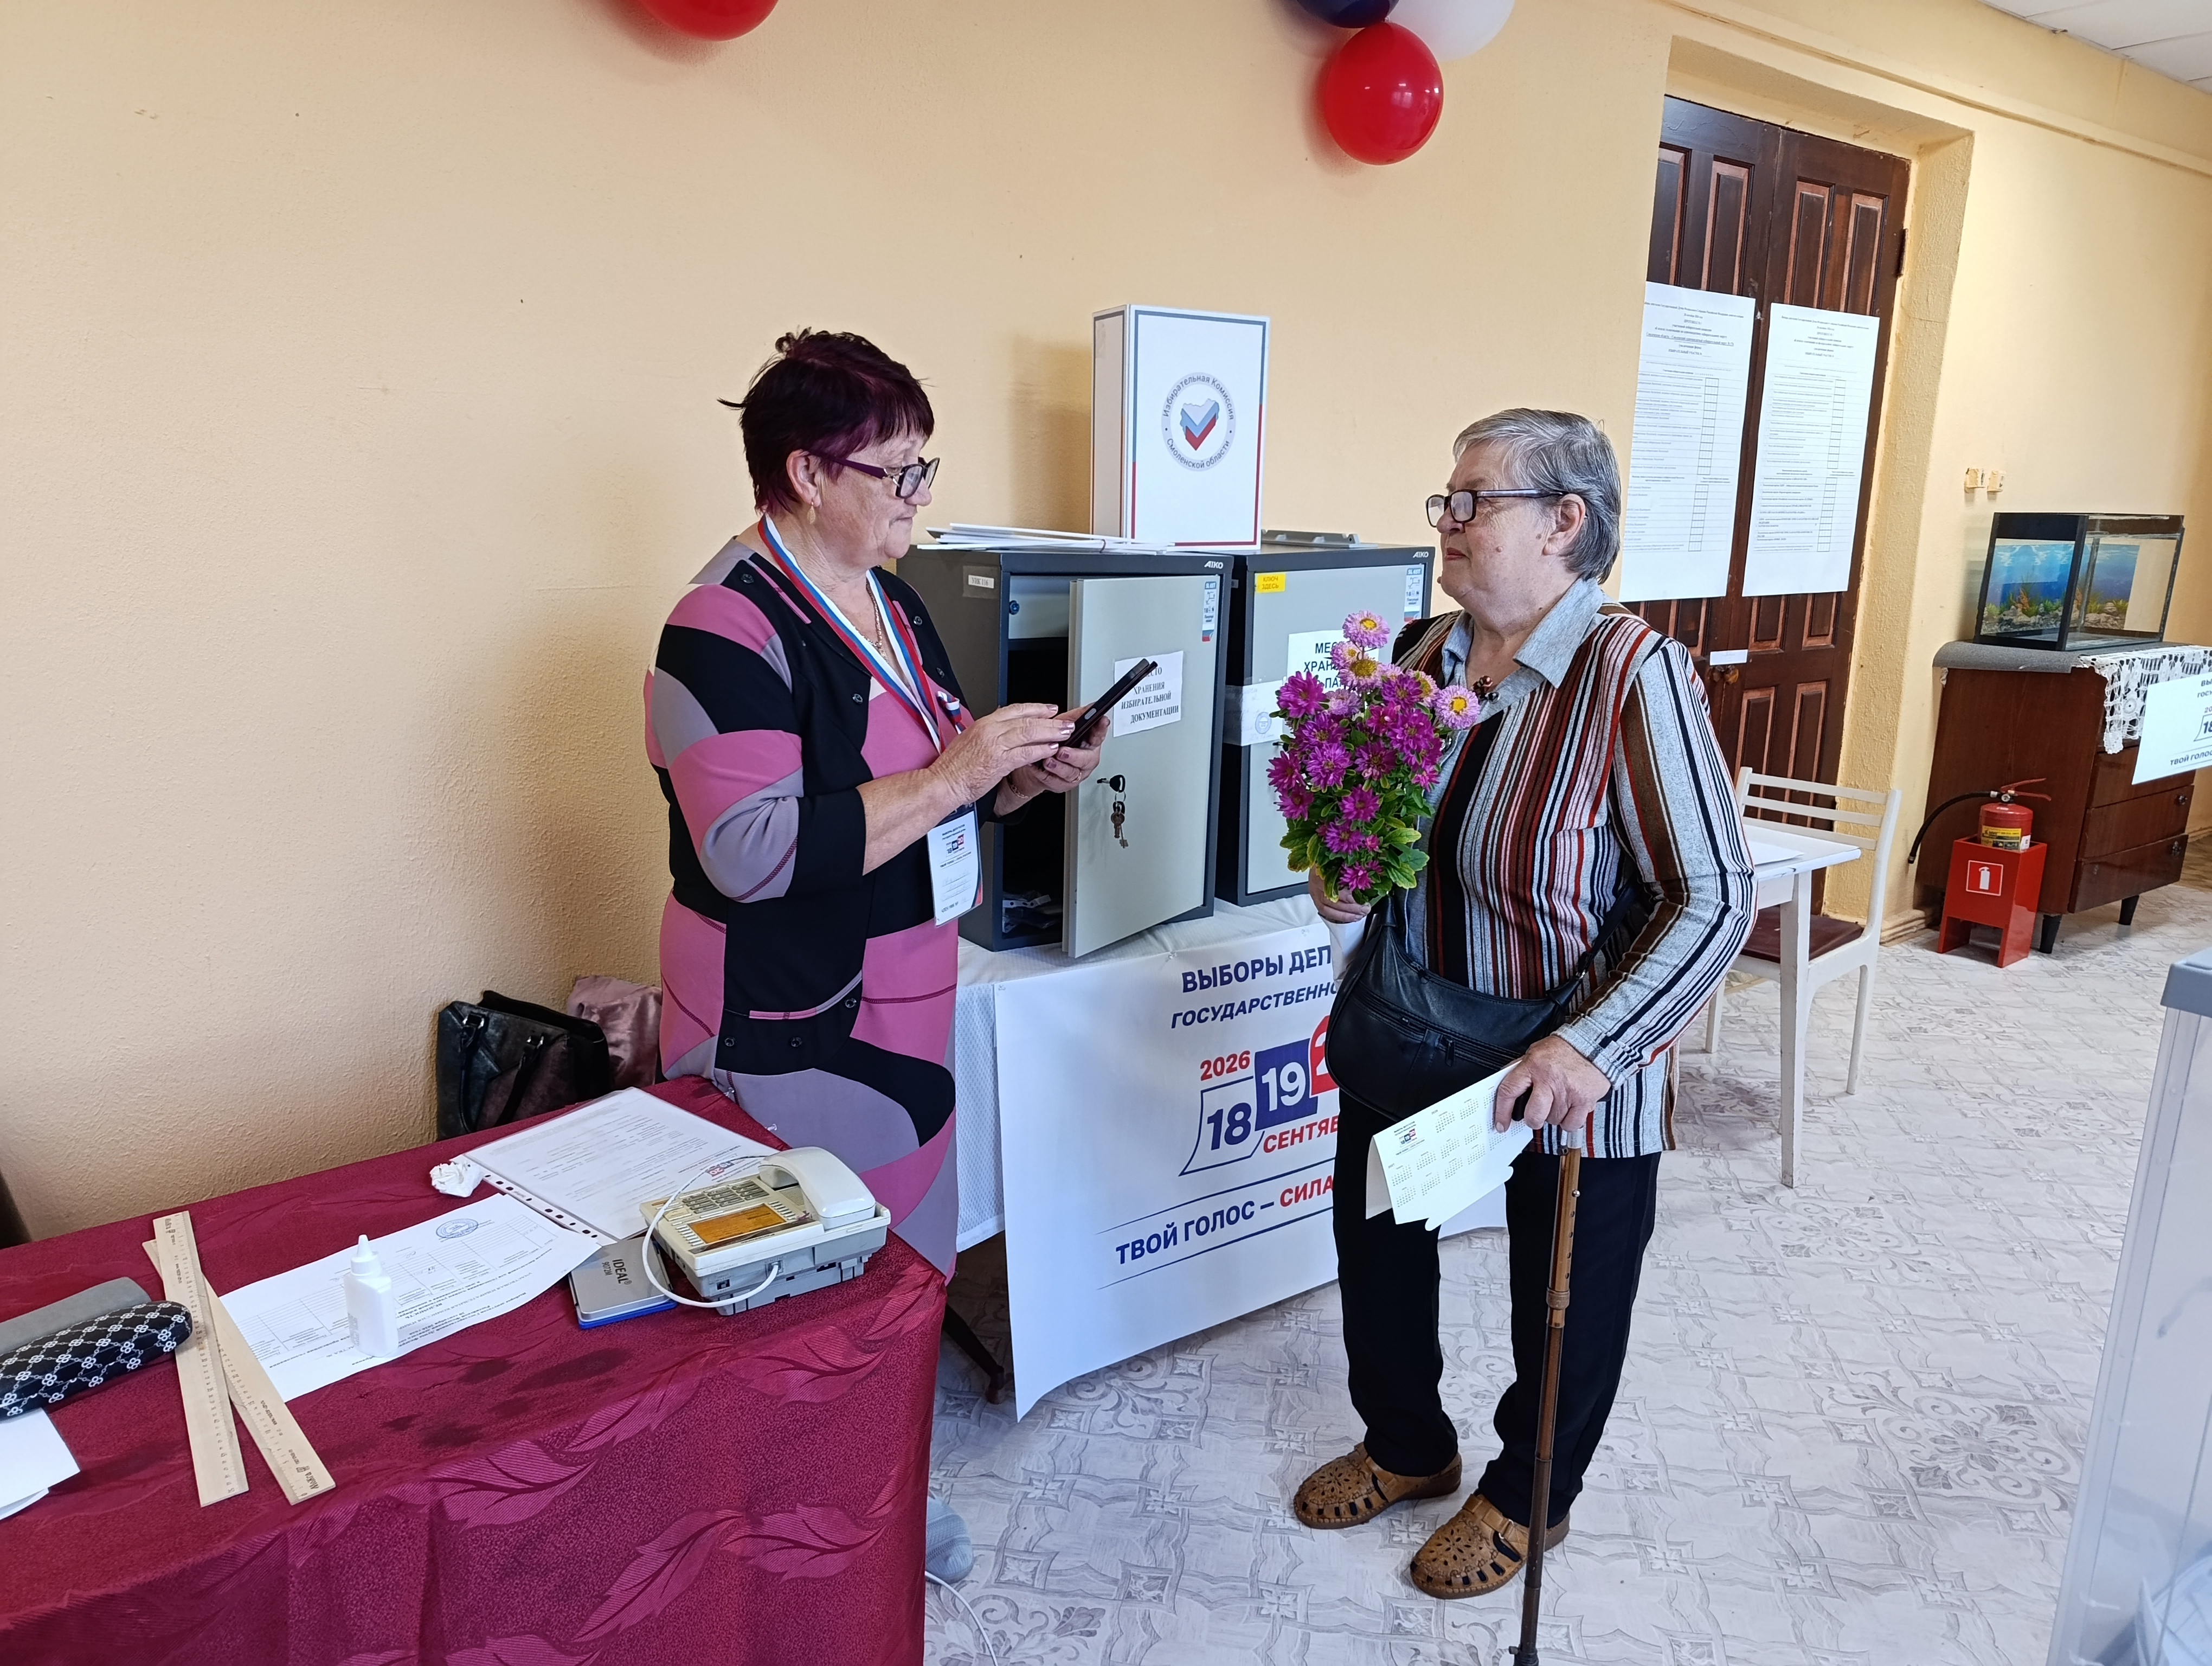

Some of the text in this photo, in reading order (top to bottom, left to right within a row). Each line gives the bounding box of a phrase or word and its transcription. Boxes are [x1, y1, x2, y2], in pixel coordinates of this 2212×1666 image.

[1162, 374, 1234, 420] Избирательная Комиссия
[1166, 438, 1231, 469] Смоленской области
[1146, 667, 1162, 677] ЕСТО
[1304, 661, 1333, 672] ХРАН
[1121, 691, 1171, 709] ИЗБИРАТЕЛЬНОЙ
[1134, 682, 1165, 695] ХРАНЕНИЯ
[1130, 705, 1179, 724] ДОКУМЕНТАЦИИ
[2170, 755, 2189, 766] ТВОЙ
[1182, 945, 1332, 994] ВЫБОРЫ ДЕП
[1171, 981, 1336, 1029] ГОСУДАРСТВЕНН
[1200, 1050, 1251, 1081] 2026
[1206, 1102, 1252, 1151] 18
[1262, 1061, 1306, 1111] 19
[1263, 1116, 1339, 1154] СЕНТЯБ
[1116, 1226, 1178, 1264] ТВОЙ
[1184, 1200, 1255, 1242] ГОЛОС
[1280, 1179, 1333, 1207] СИЛА
[602, 1261, 613, 1276] 9072M
[397, 1320, 416, 1330] ИЗБИР
